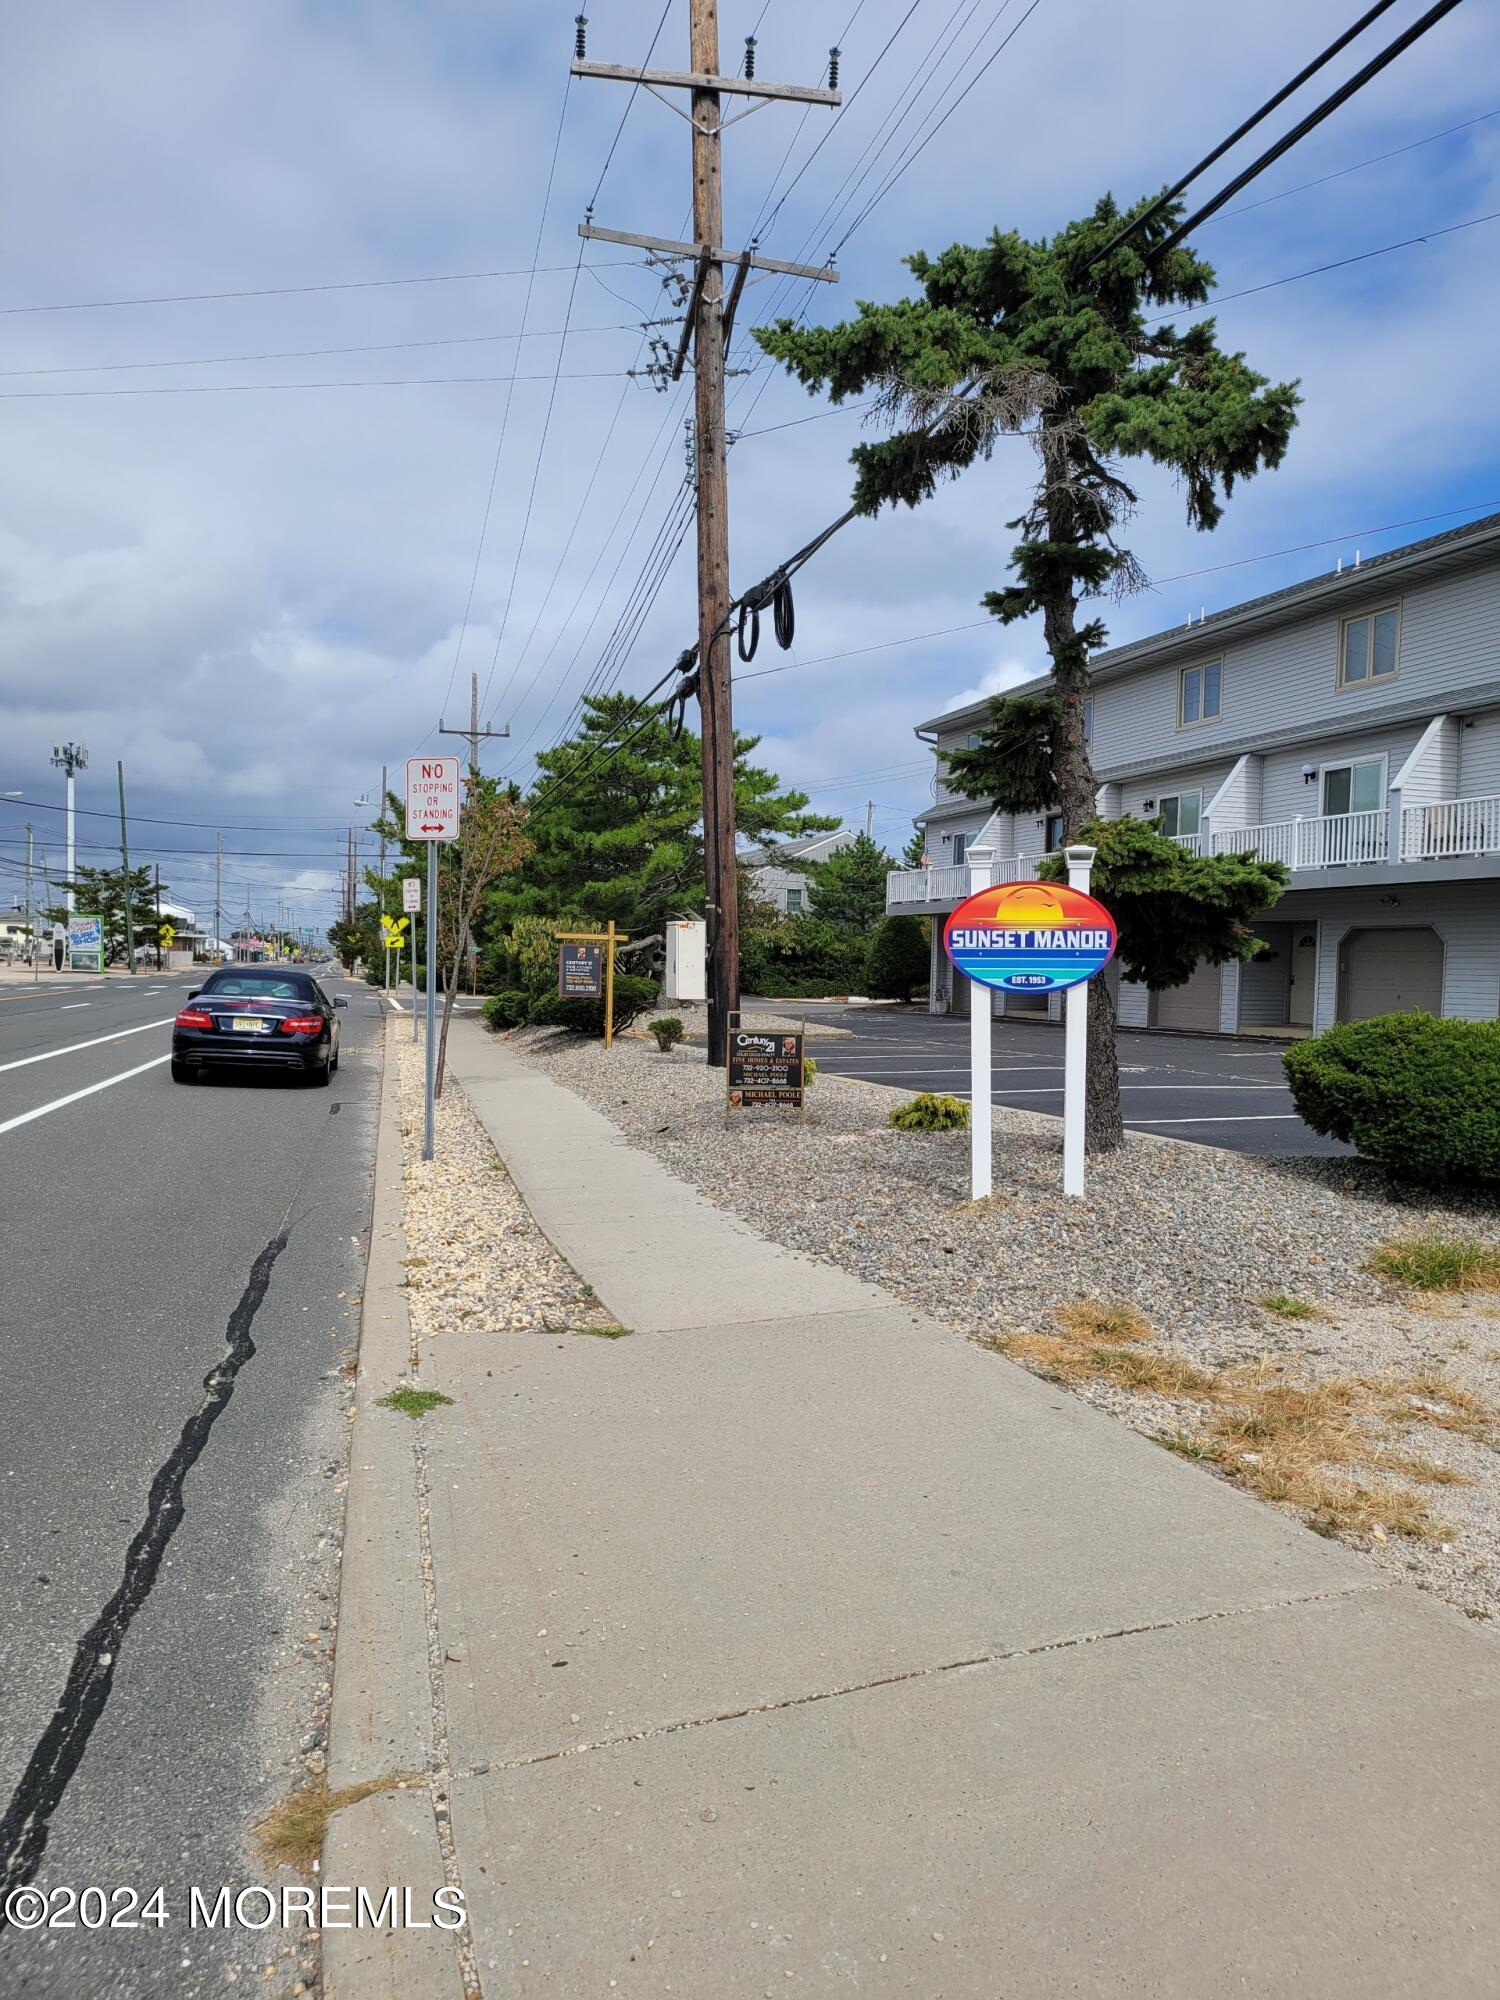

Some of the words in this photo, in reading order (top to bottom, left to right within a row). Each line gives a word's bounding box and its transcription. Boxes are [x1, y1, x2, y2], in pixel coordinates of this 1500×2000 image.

[422, 763, 443, 779] NO
[412, 783, 453, 793] STOPPING
[427, 796, 439, 806] OR
[412, 809, 453, 819] STANDING
[71, 931, 95, 940] SURF
[73, 936, 99, 945] SHOP
[952, 930, 1030, 948] SUNSET
[1034, 930, 1108, 948] MANOR
[1011, 975, 1028, 984] EST.
[1029, 975, 1046, 984] 1953
[737, 1034, 769, 1046] Century
[765, 1041, 775, 1052] 21
